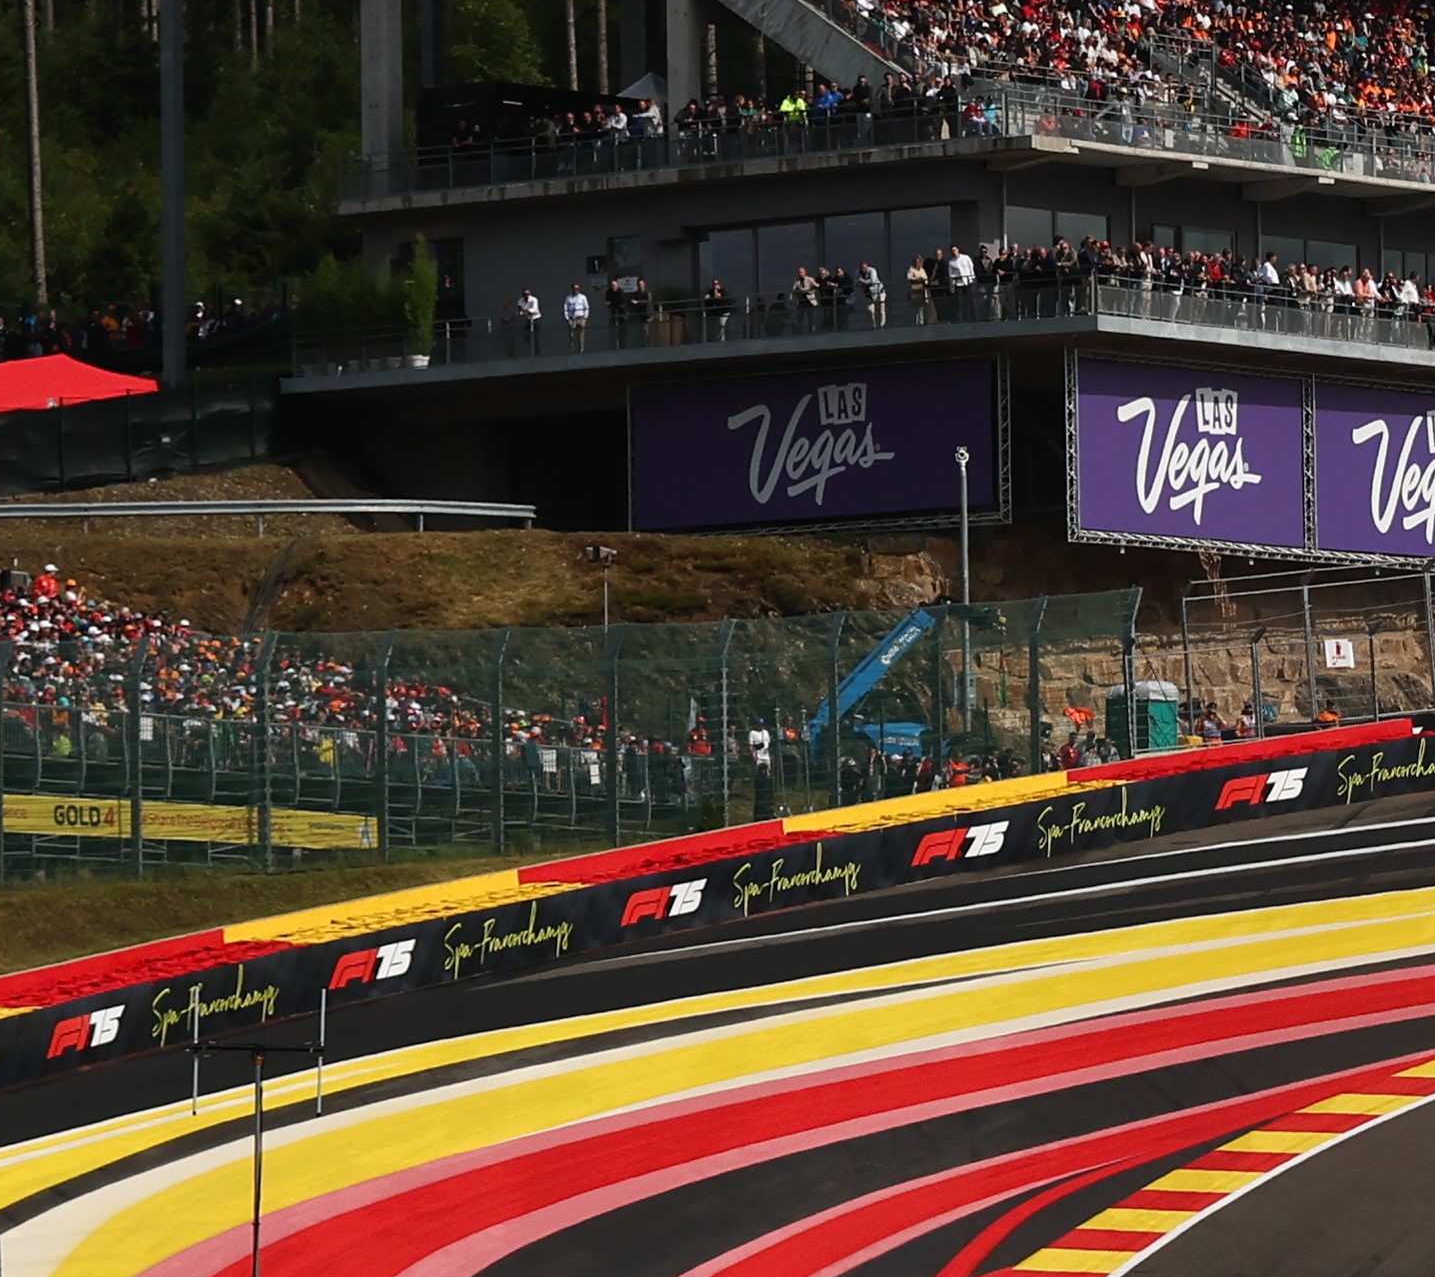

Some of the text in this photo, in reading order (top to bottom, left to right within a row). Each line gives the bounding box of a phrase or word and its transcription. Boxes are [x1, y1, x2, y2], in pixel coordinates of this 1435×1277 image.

[821, 385, 864, 422] LAS
[1198, 391, 1236, 431] LAS
[728, 393, 895, 506] Vegas
[1117, 394, 1262, 526] Vegas
[54, 804, 101, 828] GOLD
[102, 806, 117, 828] 4
